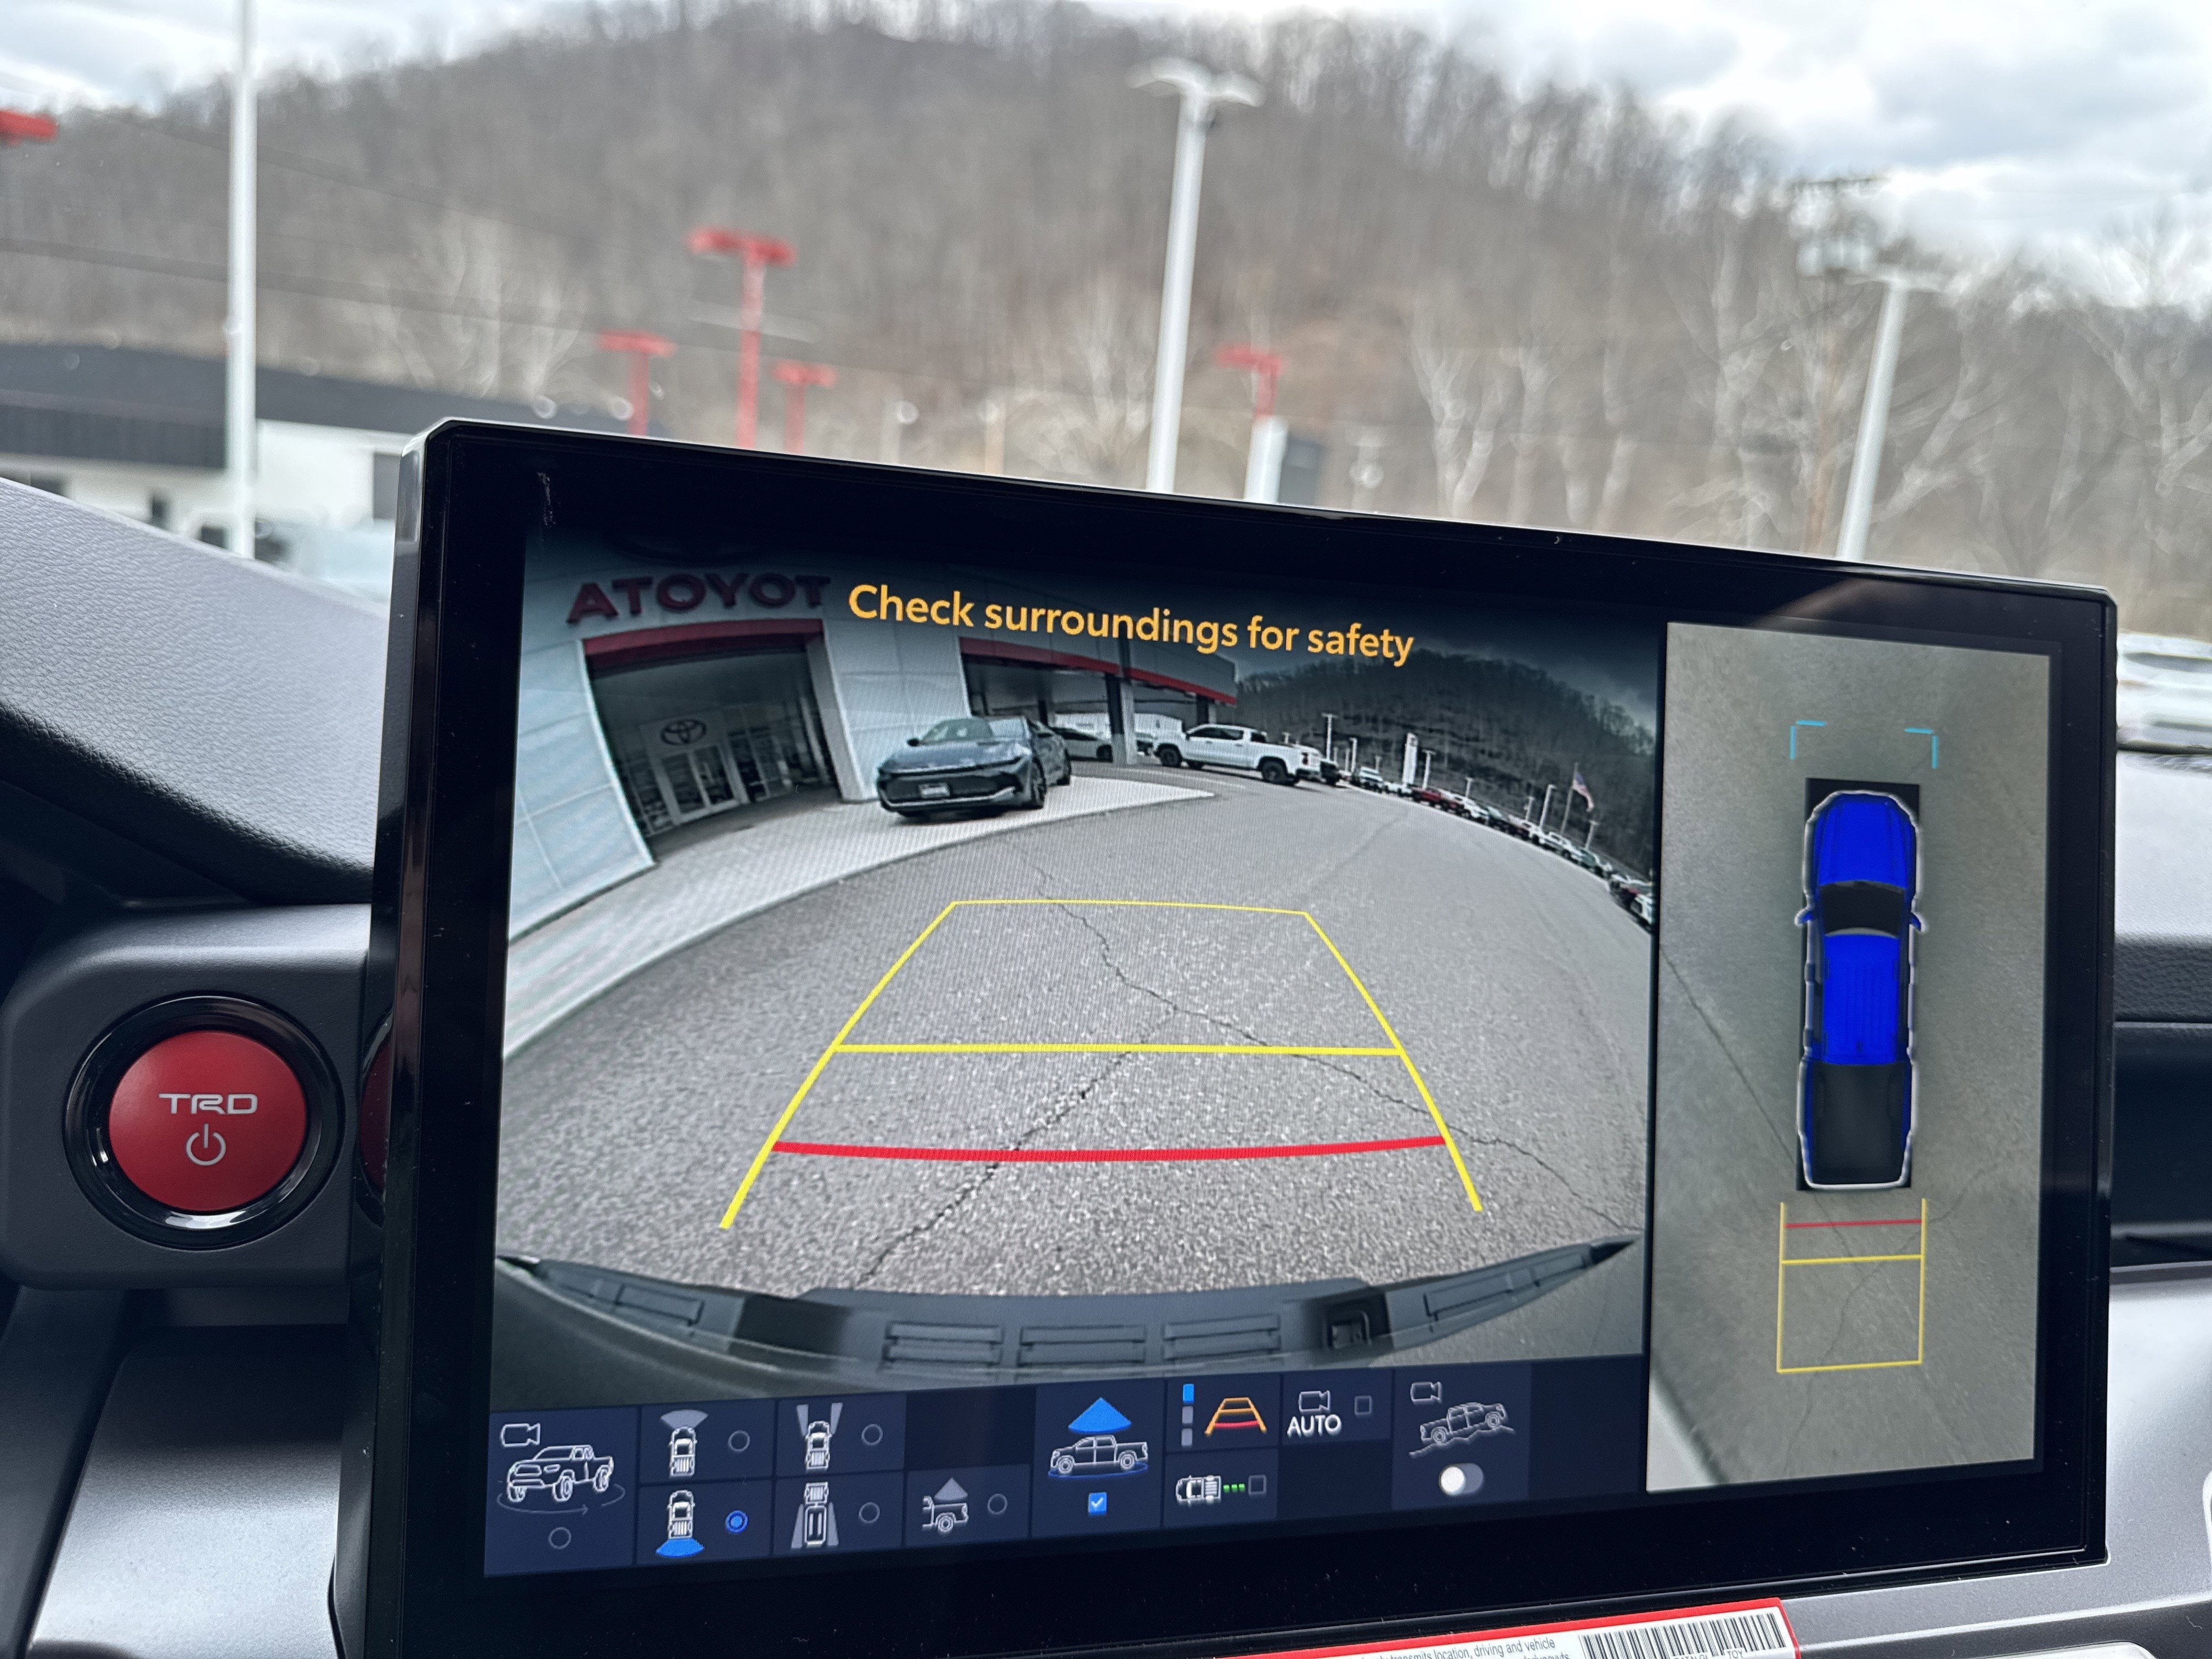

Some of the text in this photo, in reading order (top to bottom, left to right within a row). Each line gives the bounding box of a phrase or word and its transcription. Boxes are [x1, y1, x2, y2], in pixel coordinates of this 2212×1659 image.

[849, 584, 1414, 667] Check surroundings for safety
[159, 1093, 258, 1115] TRD
[1287, 1414, 1342, 1437] AUTO
[1474, 1643, 1504, 1657] driving
[1506, 1640, 1522, 1653] and
[1525, 1637, 1555, 1651] vehicle
